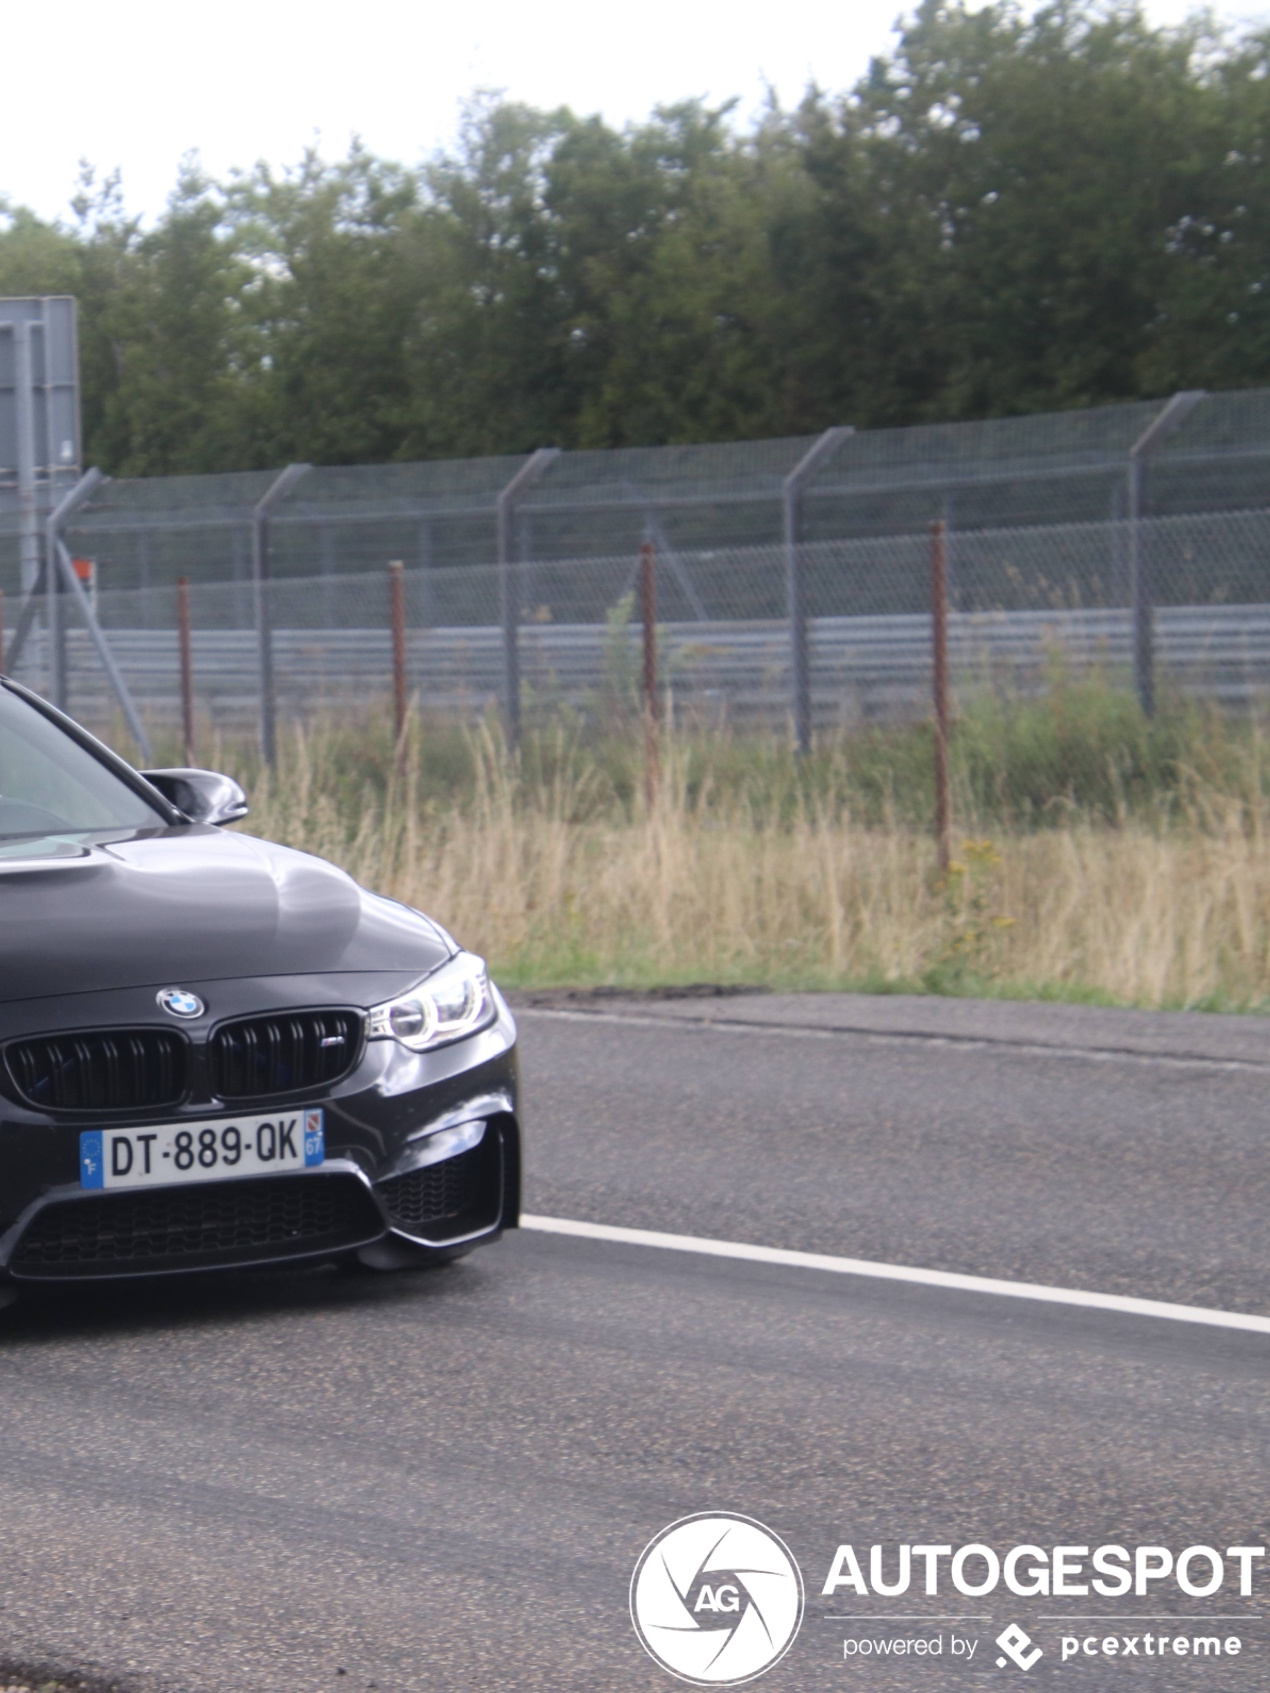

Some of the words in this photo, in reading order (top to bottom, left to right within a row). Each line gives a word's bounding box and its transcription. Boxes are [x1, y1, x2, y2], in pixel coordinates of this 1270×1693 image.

[111, 1119, 298, 1176] DT-889-QK
[306, 1137, 321, 1156] 67
[88, 1163, 97, 1175] F
